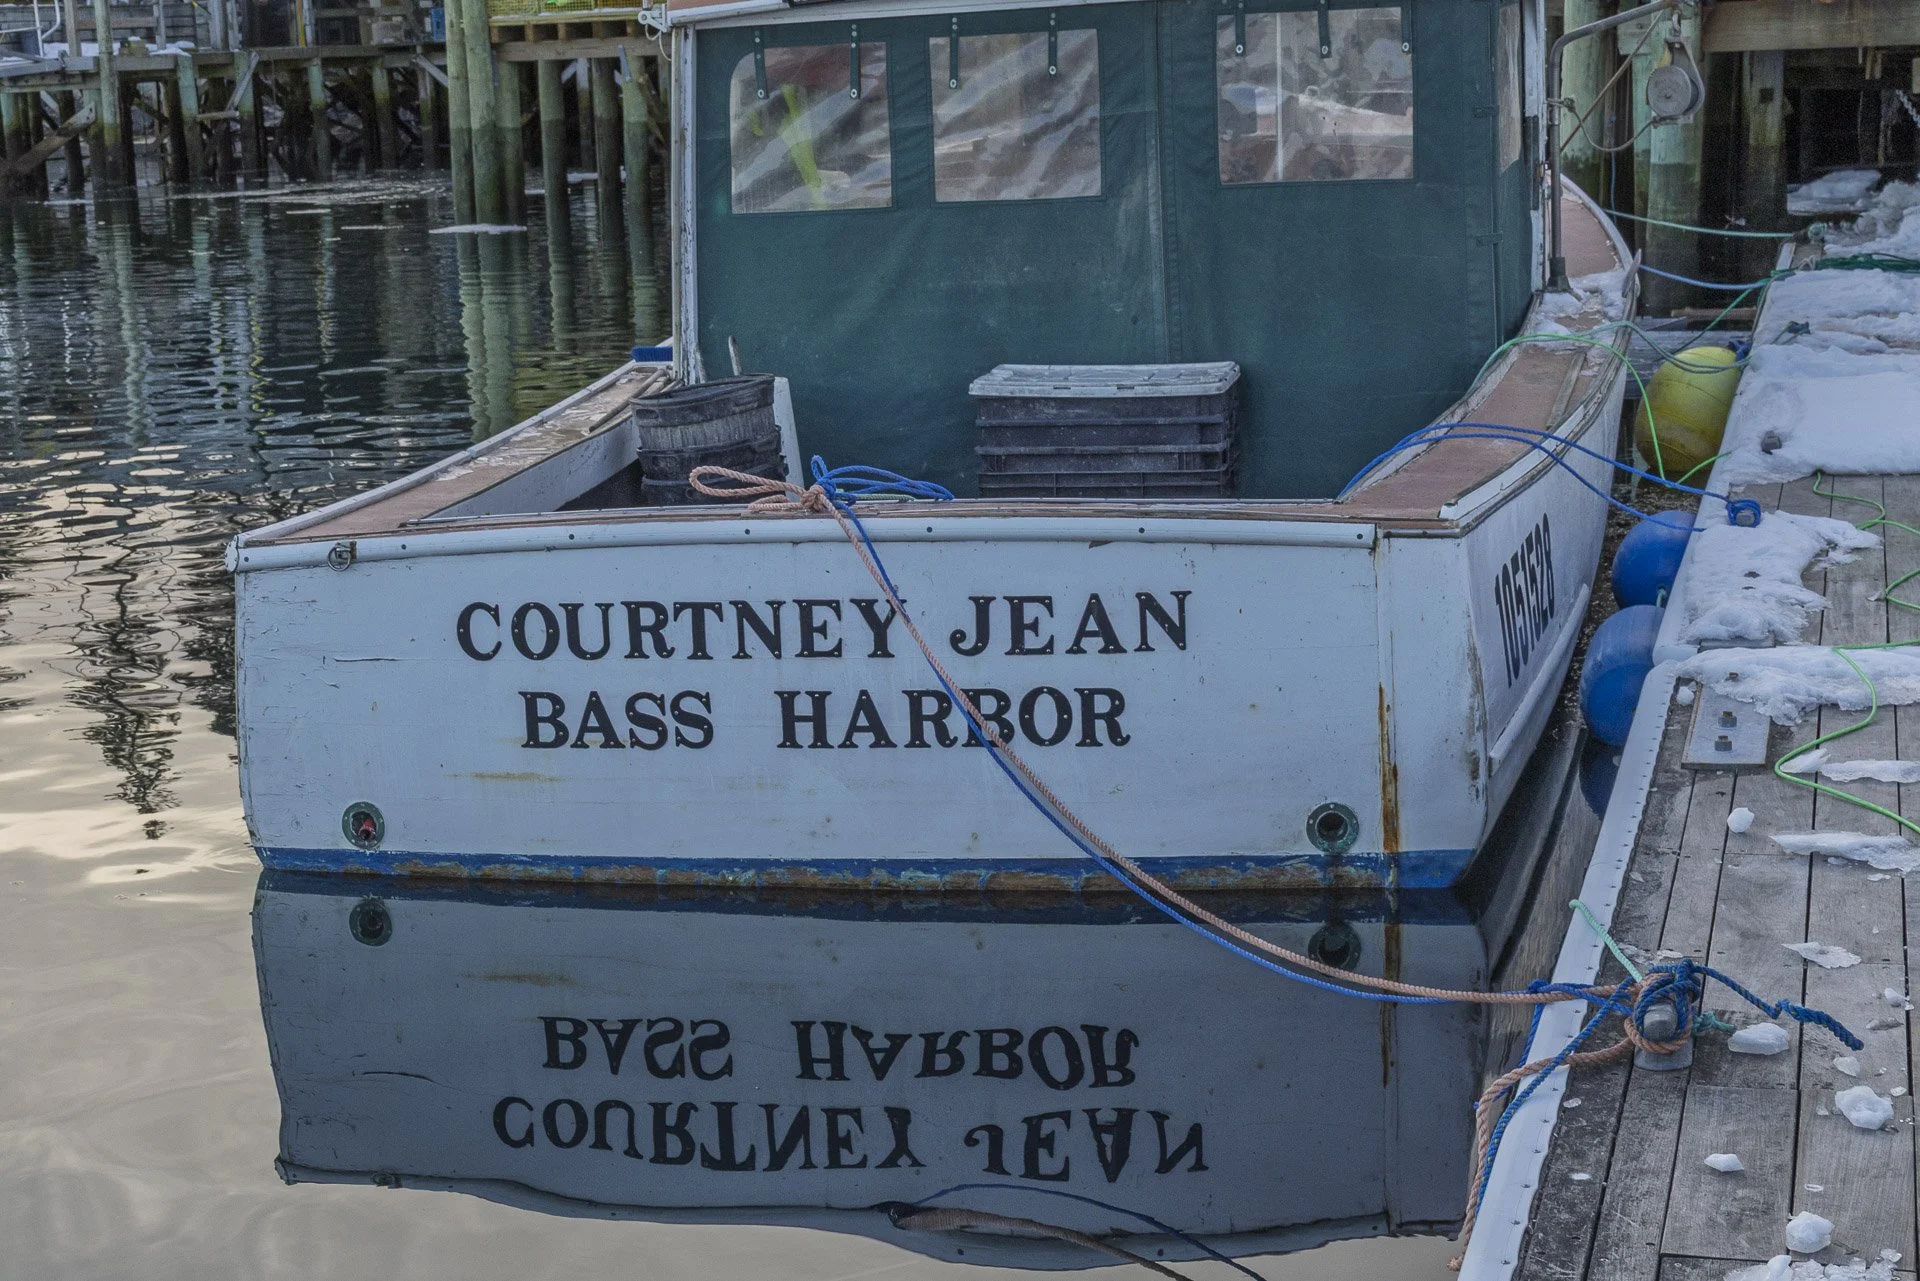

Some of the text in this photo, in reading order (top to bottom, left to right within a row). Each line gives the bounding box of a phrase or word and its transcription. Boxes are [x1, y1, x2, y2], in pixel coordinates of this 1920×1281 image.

[456, 590, 1192, 661] COURTNEY JEAN
[1495, 513, 1554, 688] 1051528
[518, 686, 1131, 750] BASS HARBOR
